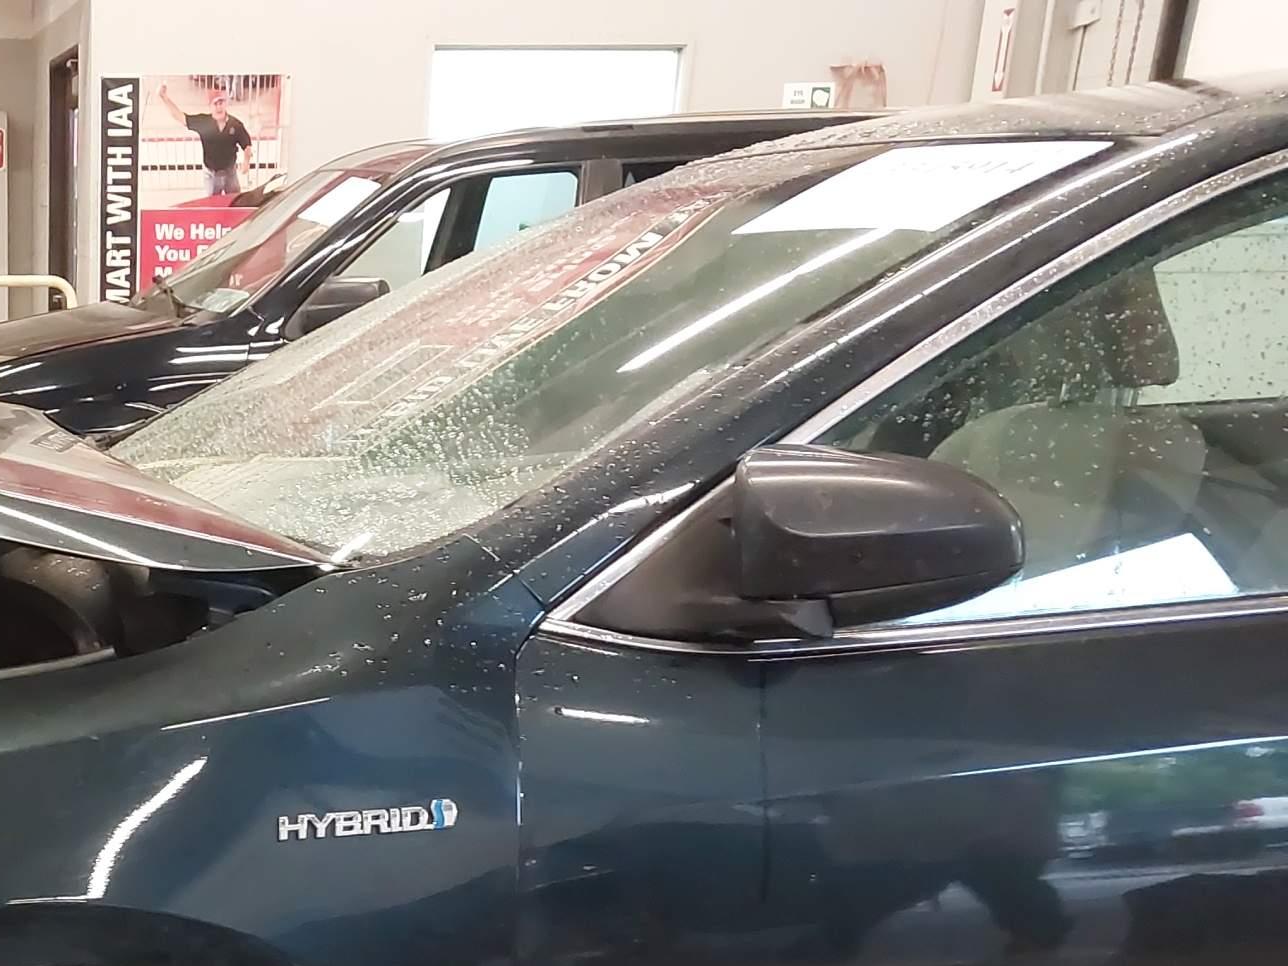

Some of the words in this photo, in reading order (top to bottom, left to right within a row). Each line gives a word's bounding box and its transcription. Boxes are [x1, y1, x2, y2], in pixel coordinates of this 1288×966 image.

[107, 84, 134, 137] IAA
[106, 146, 132, 225] WITH
[154, 223, 184, 241] We
[154, 245, 190, 262] You
[105, 231, 132, 305] MART
[277, 806, 435, 841] HYBRID
